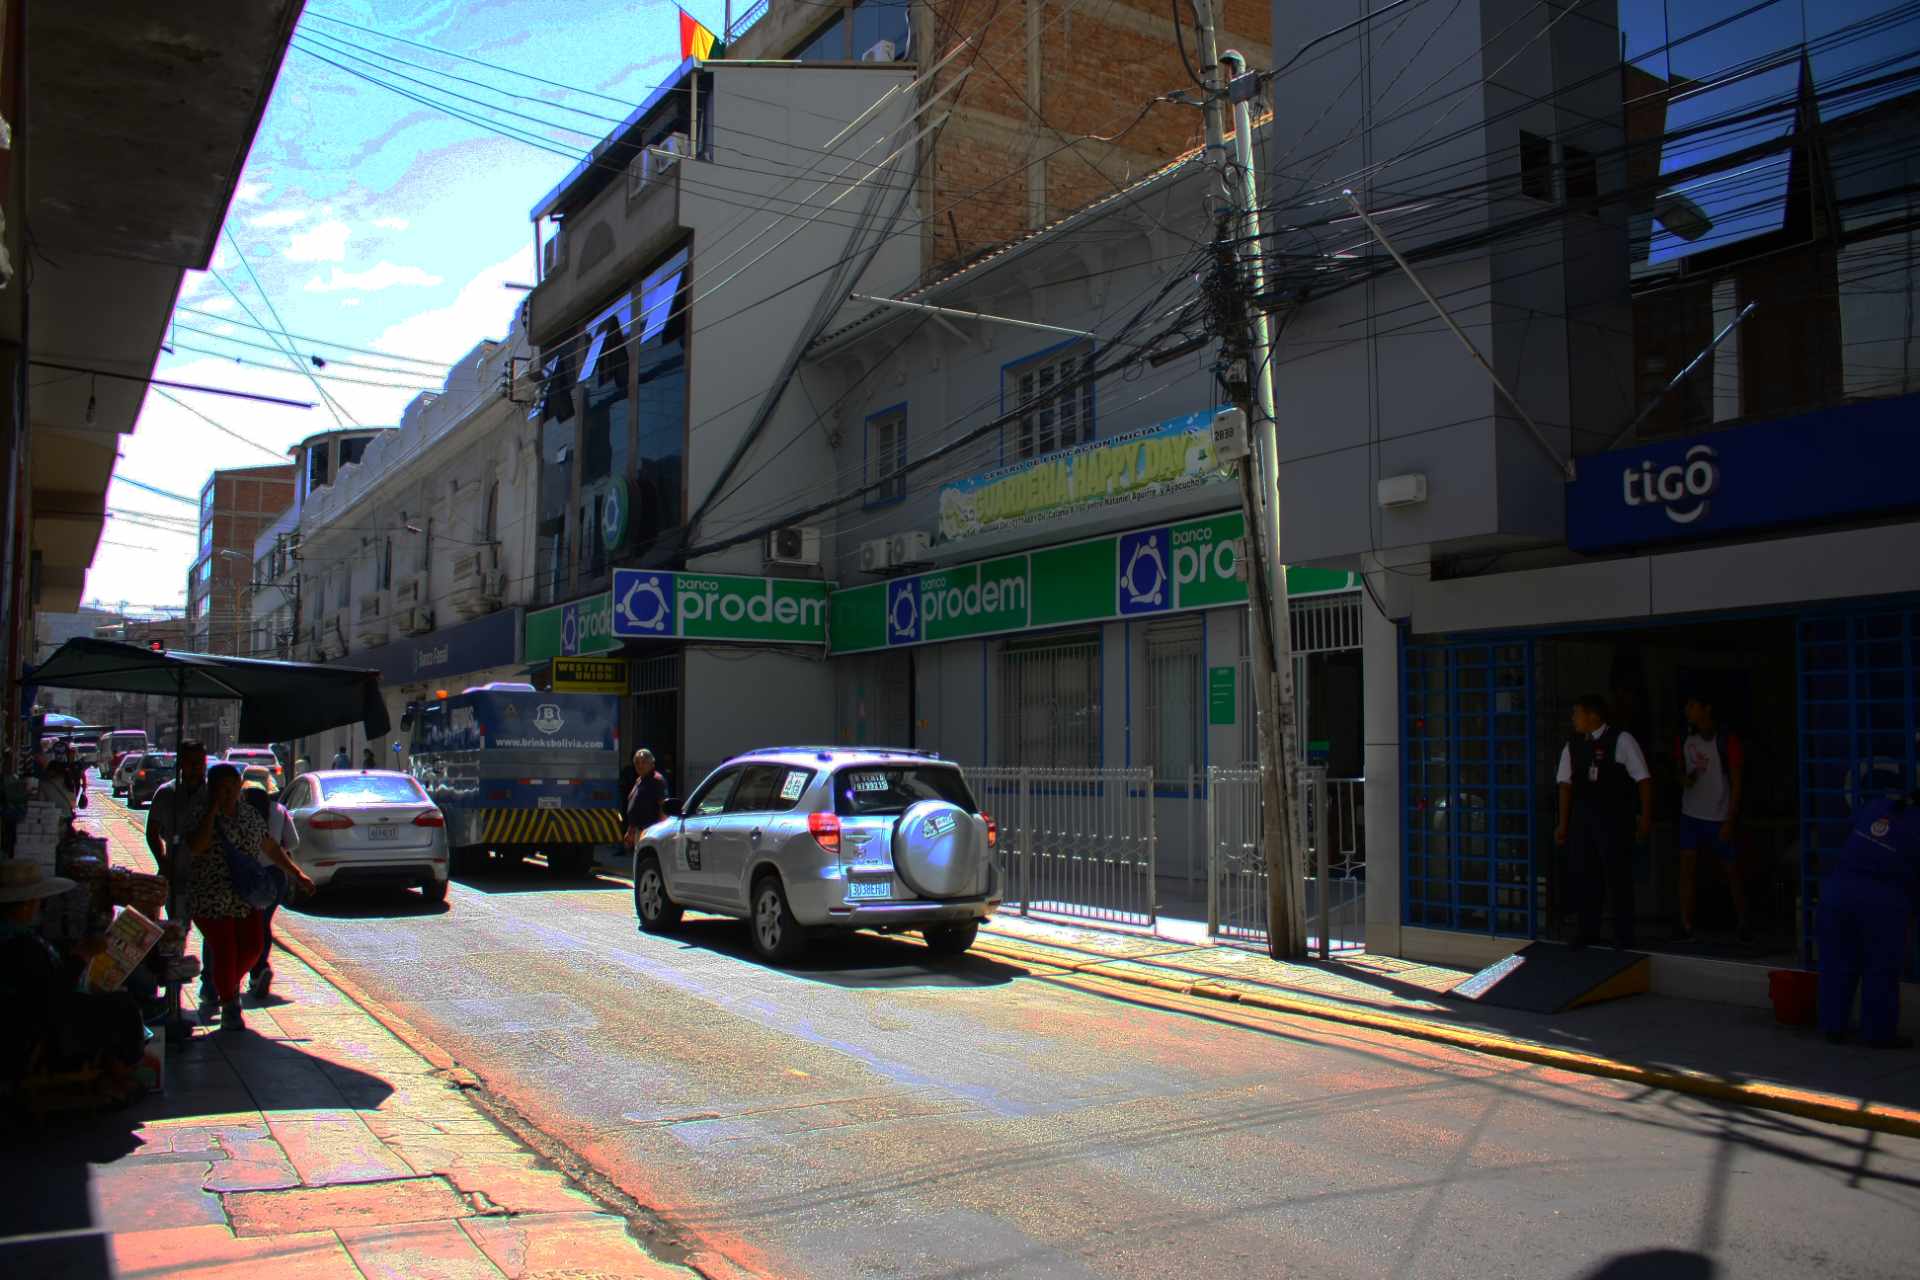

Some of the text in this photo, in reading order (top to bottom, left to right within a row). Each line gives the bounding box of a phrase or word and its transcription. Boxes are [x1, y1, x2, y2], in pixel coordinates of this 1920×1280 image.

[984, 461, 1024, 480] CENTRO
[1043, 439, 1110, 464] EDUCACION
[1115, 424, 1163, 444] INICIAL
[1072, 442, 1139, 500] HAPPY
[1144, 433, 1190, 482] DAY
[1166, 478, 1200, 495] Ayacucho
[1623, 445, 1716, 523] tigo
[1172, 525, 1213, 546] banco
[677, 577, 719, 592] banco
[921, 576, 946, 592] banco
[677, 578, 827, 636] prodem
[921, 562, 1026, 642] prodem
[557, 663, 614, 672] WESTERN
[575, 671, 613, 680] UNION
[496, 736, 604, 749] www.brinksbolivia.com
